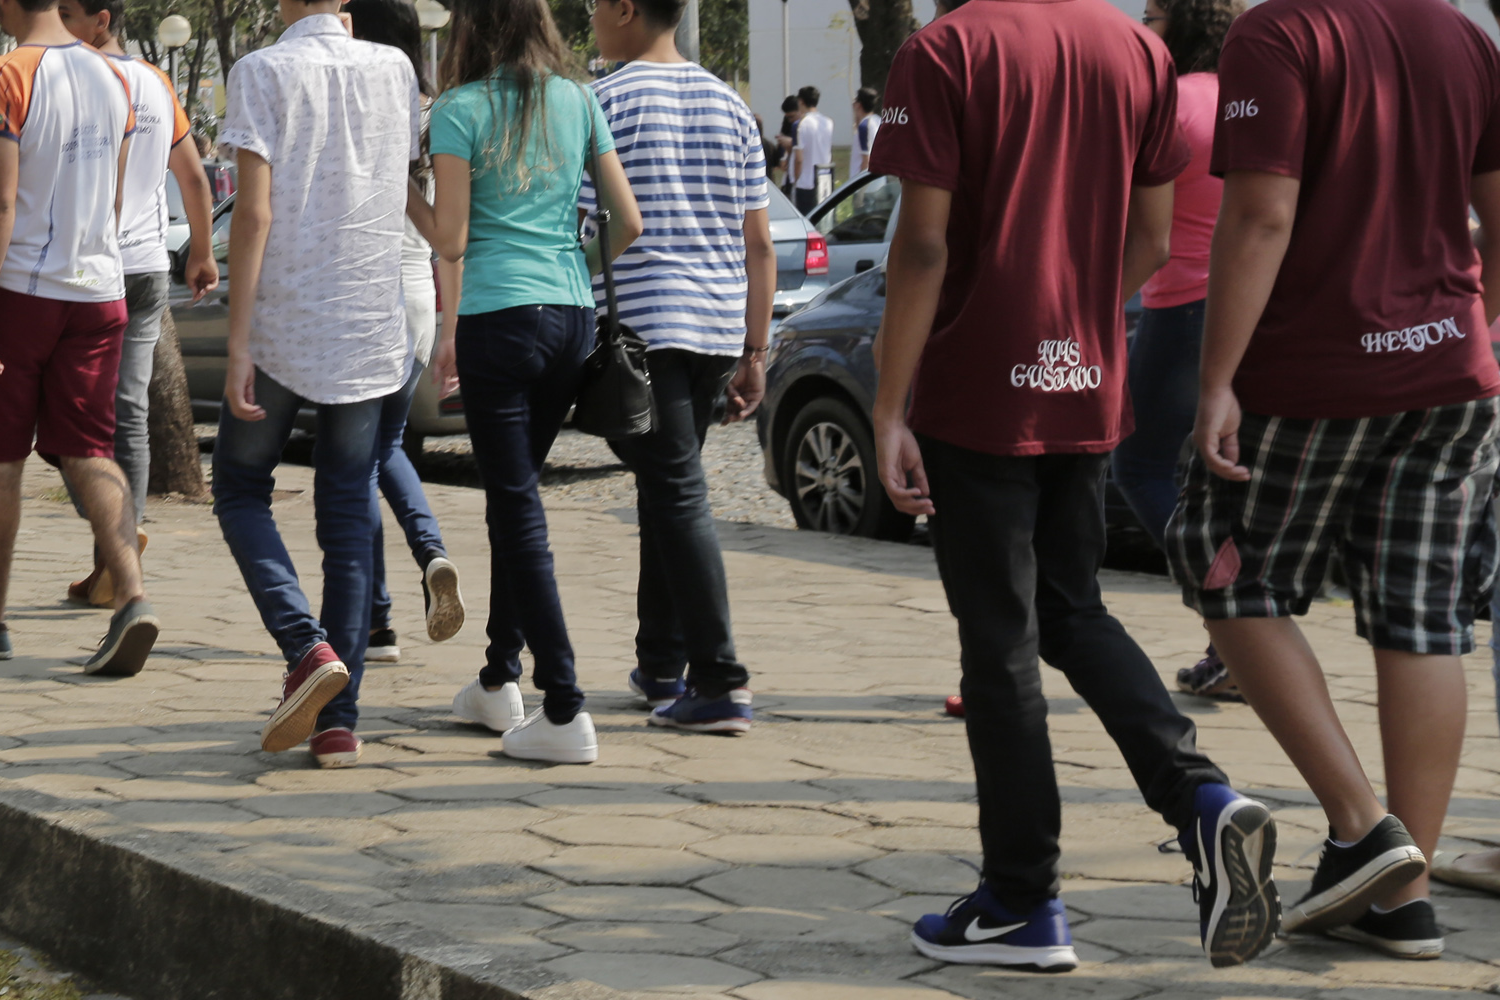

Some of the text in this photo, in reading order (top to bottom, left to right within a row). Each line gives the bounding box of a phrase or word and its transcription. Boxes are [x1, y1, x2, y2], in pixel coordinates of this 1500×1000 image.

[881, 106, 909, 124] 2016
[1225, 98, 1259, 120] 2016
[1361, 317, 1466, 353] HELTON
[1011, 363, 1102, 392] GUSTAVO
